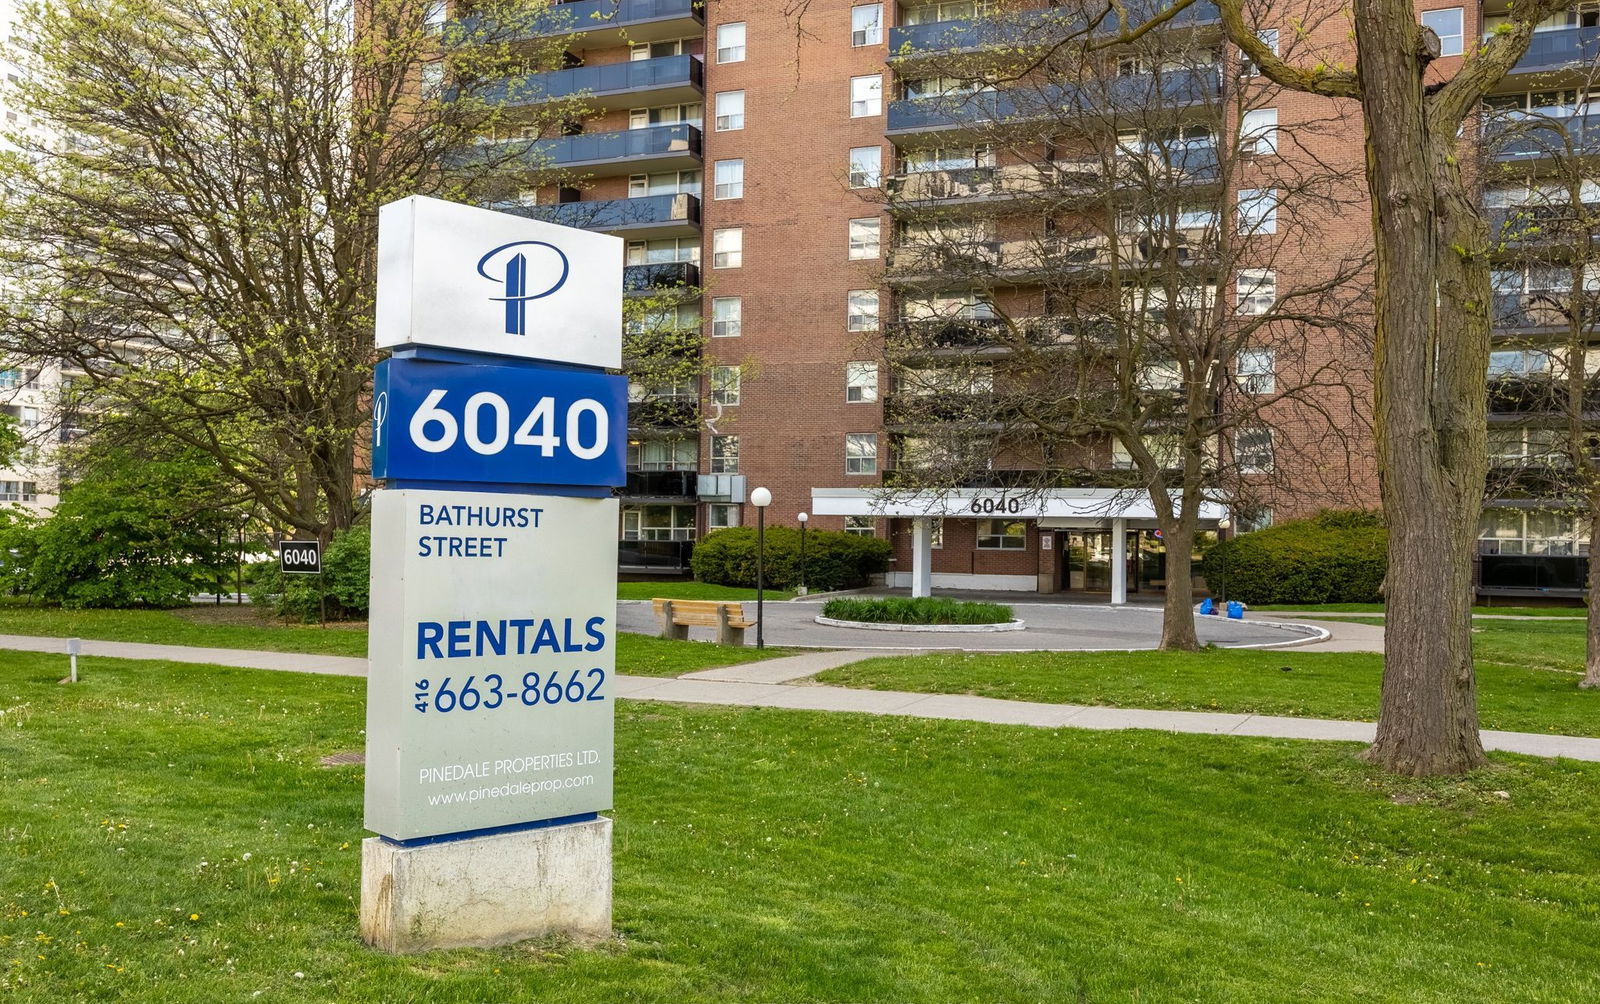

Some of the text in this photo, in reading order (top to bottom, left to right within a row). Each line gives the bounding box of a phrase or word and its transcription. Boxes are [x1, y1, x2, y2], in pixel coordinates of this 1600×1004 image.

[409, 389, 609, 460] 6040
[419, 504, 543, 528] BATHURST
[971, 498, 1019, 513] 6040
[284, 549, 317, 565] 6040
[418, 536, 507, 557] STREET
[417, 617, 605, 660] RENTALS
[415, 679, 429, 713] 416
[434, 667, 606, 713] 663-8662
[419, 749, 601, 784] PINEDALE PROPERTIES LTD.
[428, 774, 594, 806] www.pinedaleprop.com
